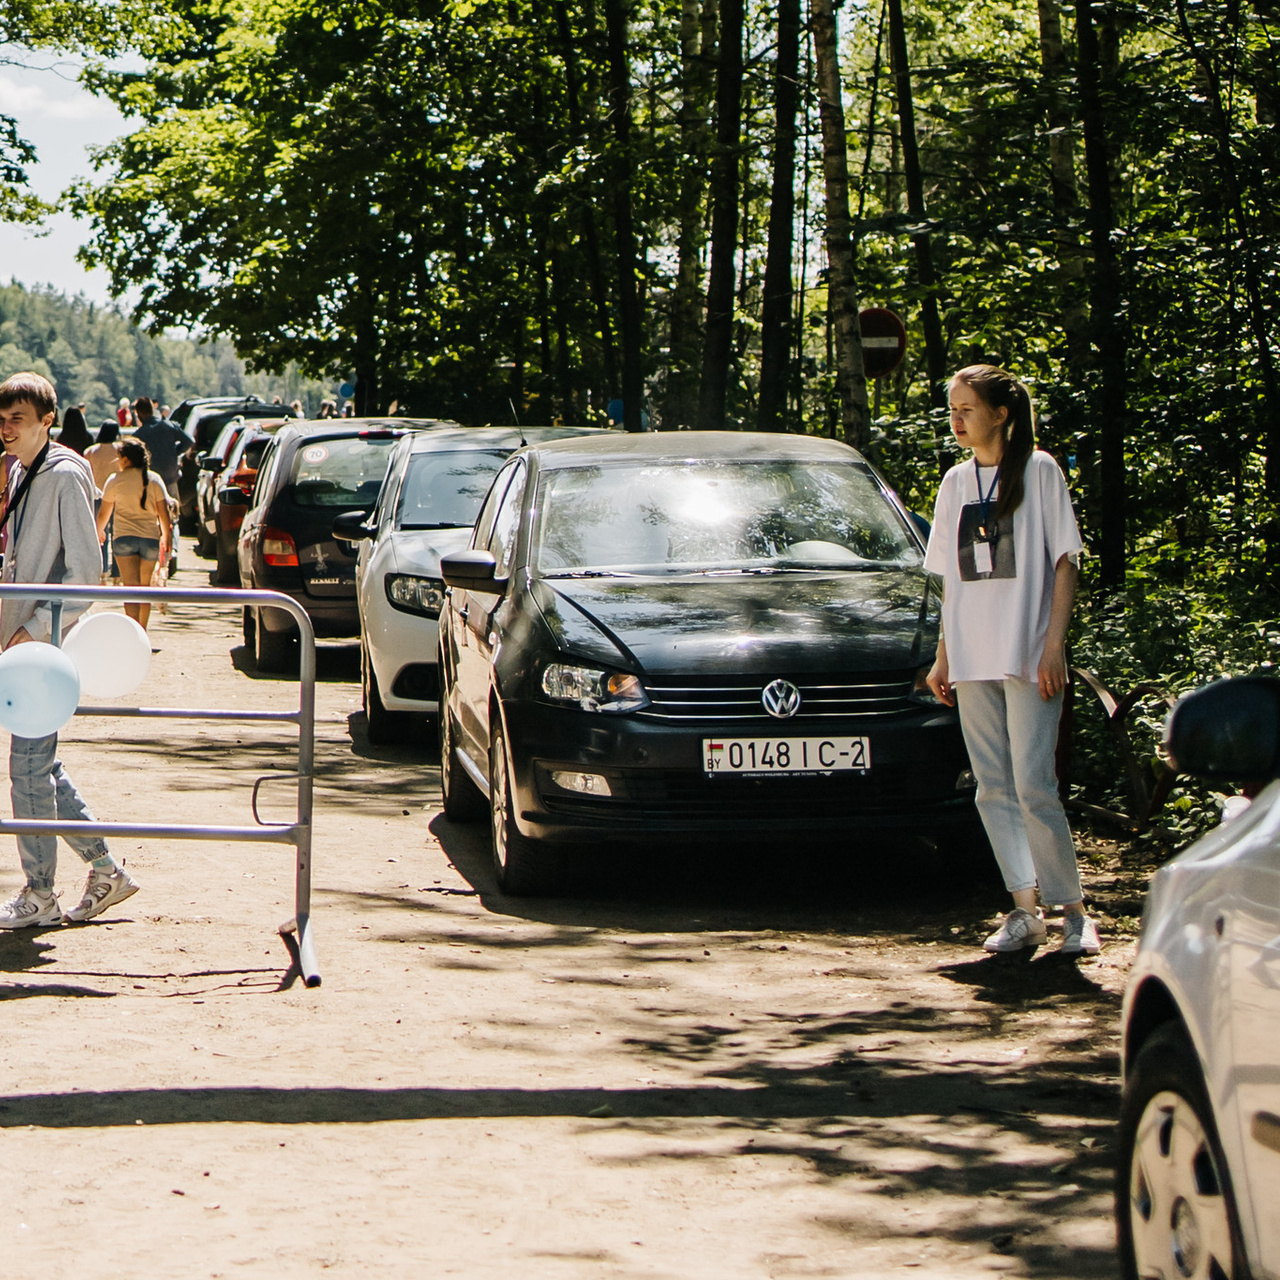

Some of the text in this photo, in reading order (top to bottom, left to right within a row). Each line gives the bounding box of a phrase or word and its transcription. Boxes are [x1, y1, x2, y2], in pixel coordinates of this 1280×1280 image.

[310, 450, 323, 458] 70
[707, 758, 722, 770] BY
[728, 742, 791, 769] 0148
